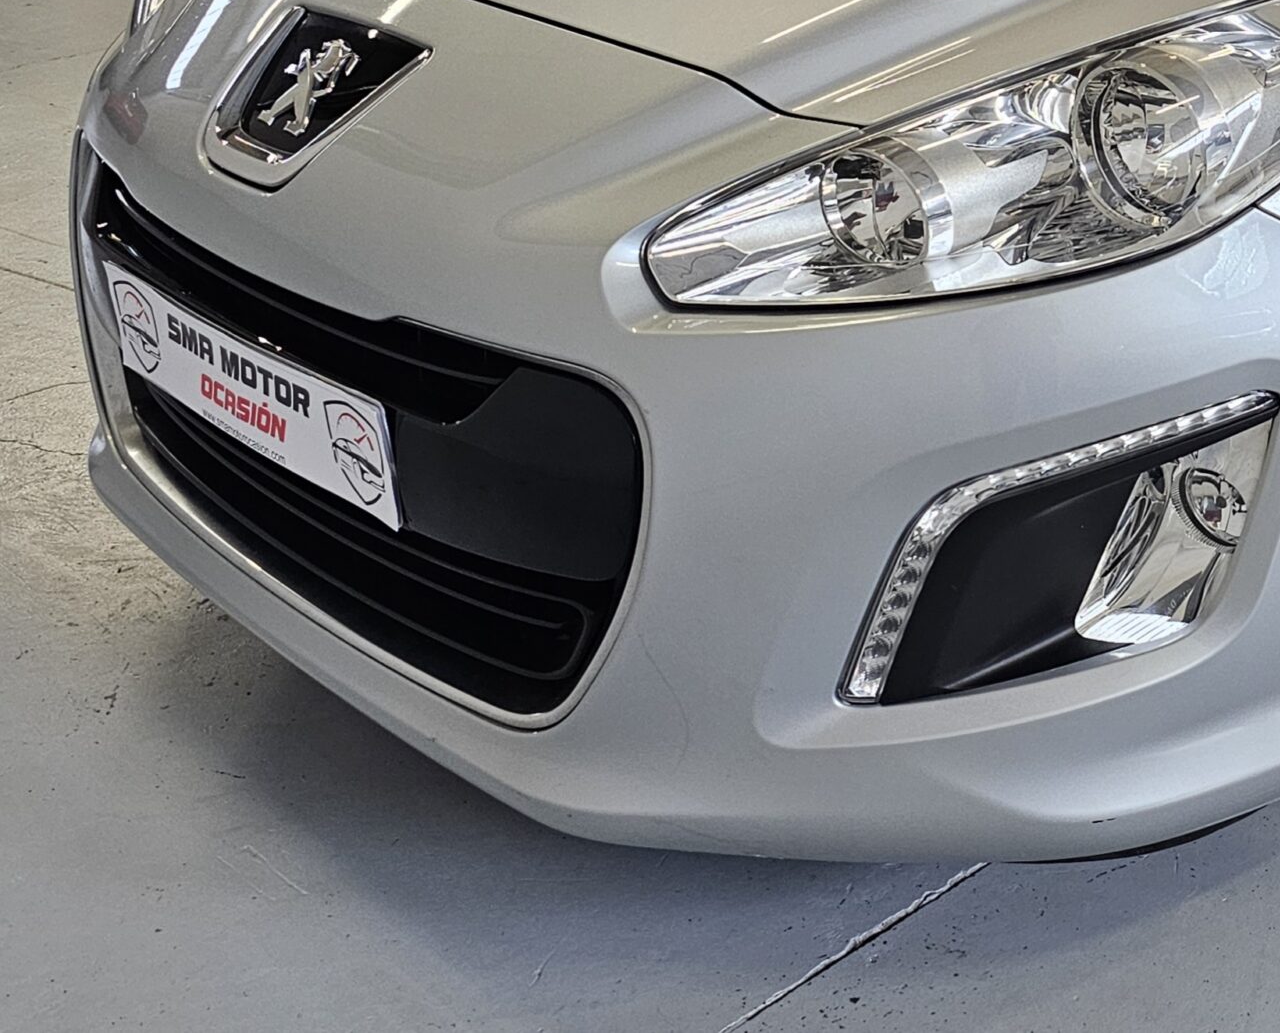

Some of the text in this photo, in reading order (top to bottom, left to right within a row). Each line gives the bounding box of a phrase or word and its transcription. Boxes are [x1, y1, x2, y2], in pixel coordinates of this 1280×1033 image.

[167, 313, 311, 418] SMA MOTOR
[200, 374, 288, 443] OCASIÓN
